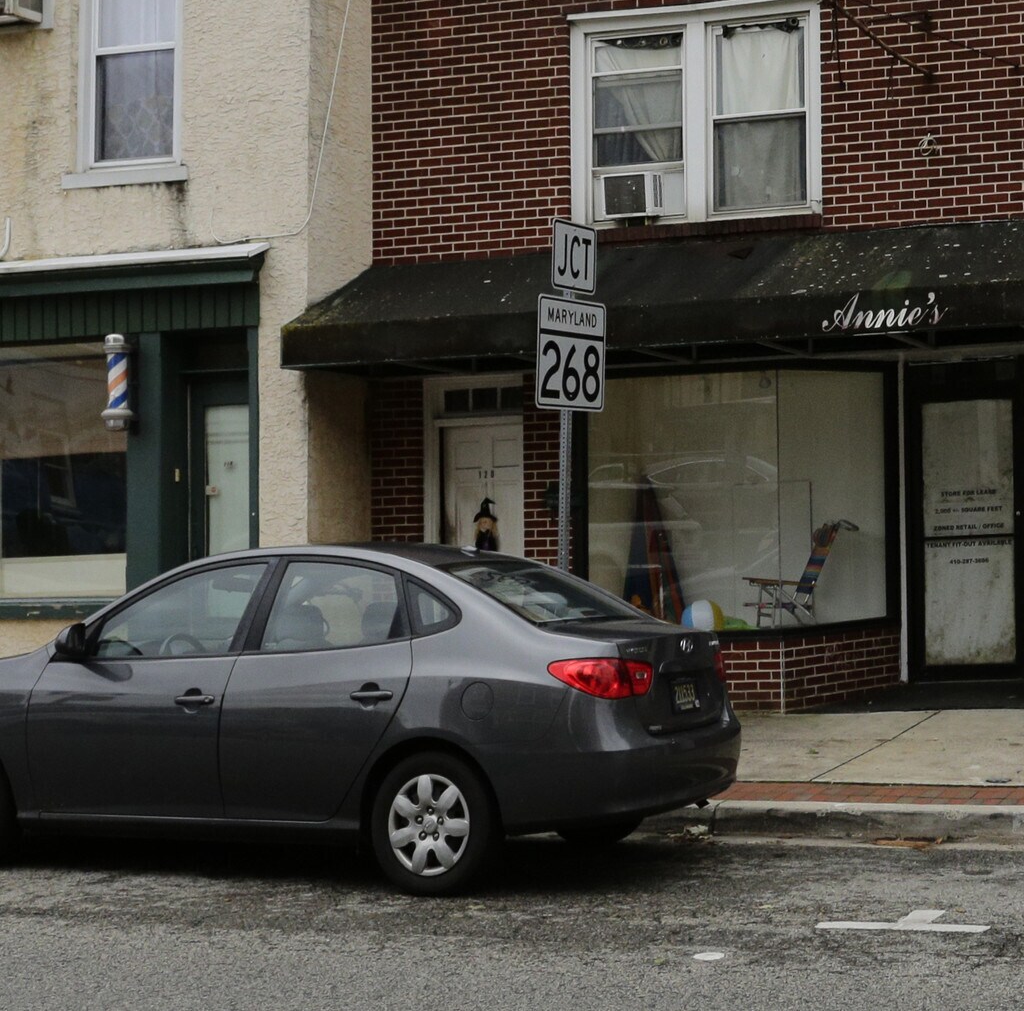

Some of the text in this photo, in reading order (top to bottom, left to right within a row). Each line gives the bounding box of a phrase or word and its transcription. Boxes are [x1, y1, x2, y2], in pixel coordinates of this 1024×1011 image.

[557, 234, 592, 280] JCT
[547, 307, 598, 328] MARYLAND
[822, 291, 949, 332] Annie's
[540, 340, 600, 403] 268
[478, 470, 494, 479] 120
